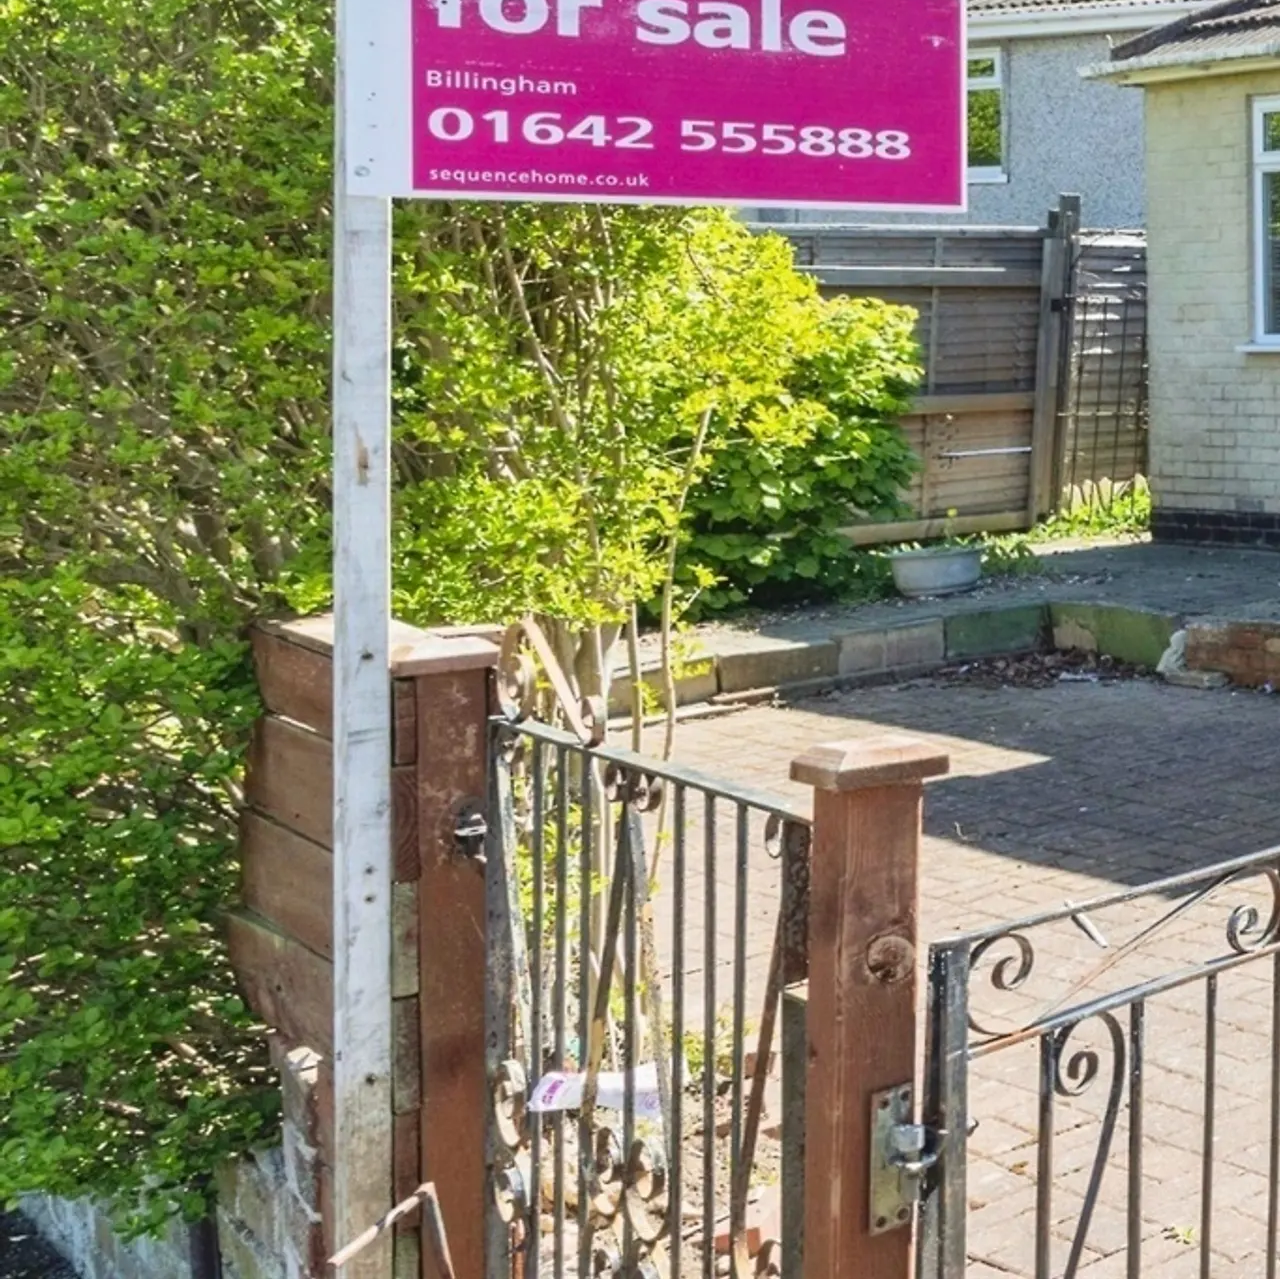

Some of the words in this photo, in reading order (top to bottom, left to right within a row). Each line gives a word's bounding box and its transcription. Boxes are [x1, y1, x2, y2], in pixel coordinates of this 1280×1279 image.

[426, 69, 578, 96] Billingham
[428, 107, 654, 149] 01642
[680, 119, 912, 160] 555888
[429, 167, 650, 187] sequencehome.co.uk
